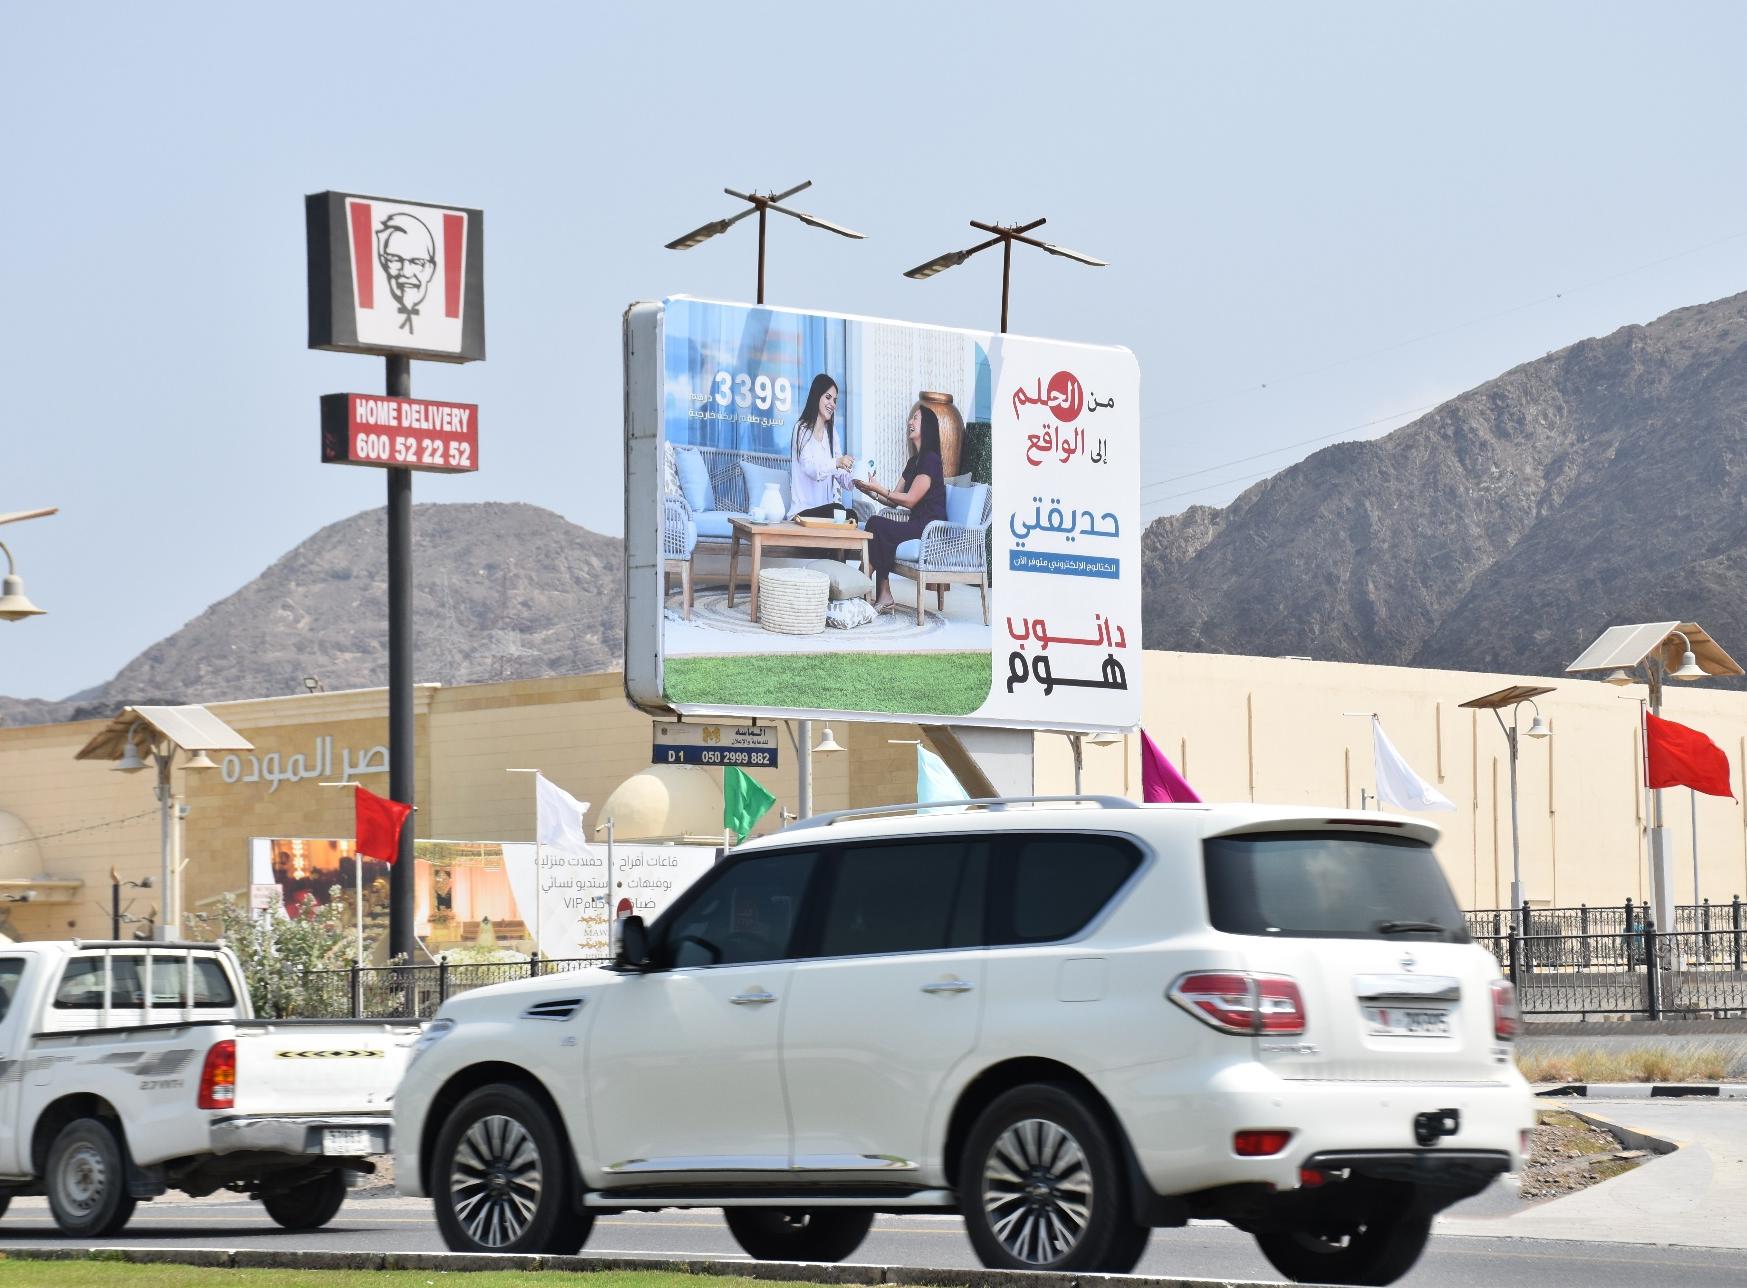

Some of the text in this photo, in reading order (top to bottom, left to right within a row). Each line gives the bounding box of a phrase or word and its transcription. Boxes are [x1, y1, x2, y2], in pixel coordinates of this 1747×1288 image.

[715, 371, 792, 411] 3399
[1012, 376, 1115, 420] من الحلم
[355, 398, 470, 433] HOME DELIVERY
[356, 432, 471, 467] 600 52 22 52
[1026, 423, 1107, 466] إلى الواقع
[1009, 496, 1120, 548] حديقتي
[1006, 613, 1127, 650] دانوب
[1006, 651, 1128, 696] هوم
[336, 745, 390, 788] صر
[668, 750, 684, 761] D 1
[702, 751, 770, 764] 050 2999 882
[564, 897, 583, 909] VIP
